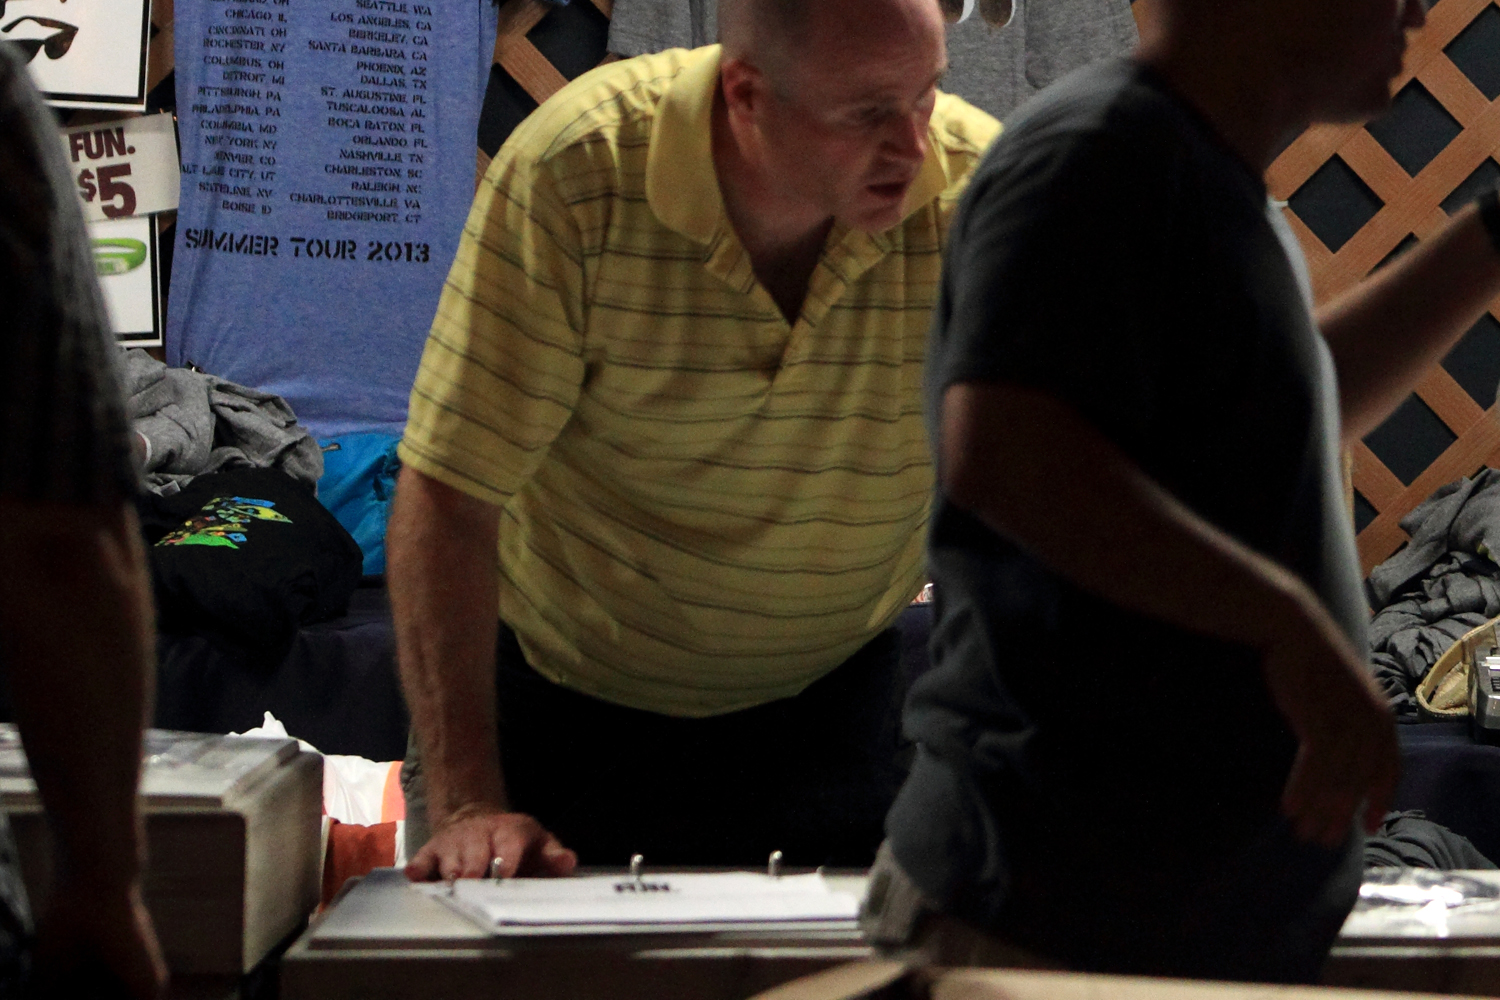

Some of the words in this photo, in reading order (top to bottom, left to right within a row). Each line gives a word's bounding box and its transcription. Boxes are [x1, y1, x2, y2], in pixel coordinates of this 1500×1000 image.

[413, 4, 432, 16] WA
[330, 12, 354, 23] LOS
[416, 21, 432, 31] CA
[271, 28, 287, 38] OH
[412, 35, 429, 46] CA
[271, 43, 286, 53] NY
[308, 40, 346, 53] SANTA
[412, 51, 428, 61] CA
[268, 60, 284, 70] OH
[410, 66, 427, 76] AZ
[412, 79, 427, 90] TX
[266, 91, 281, 101] PA
[412, 94, 427, 105] FL
[265, 107, 281, 117] PA
[410, 108, 426, 118] AL
[328, 116, 360, 129] BOCA
[410, 123, 425, 133] FL
[68, 127, 136, 163] FUN.
[263, 140, 277, 150] NY
[413, 138, 428, 149] FL
[260, 156, 276, 166] CO
[408, 153, 424, 164] TN
[261, 171, 277, 181] UT
[407, 168, 422, 179] SC
[77, 163, 137, 219] $5
[257, 187, 273, 198] NV
[403, 199, 421, 209] VA
[405, 214, 421, 224] CT
[185, 228, 279, 257] SUMMER
[289, 236, 357, 260] TOUR
[367, 240, 430, 263] 2013
